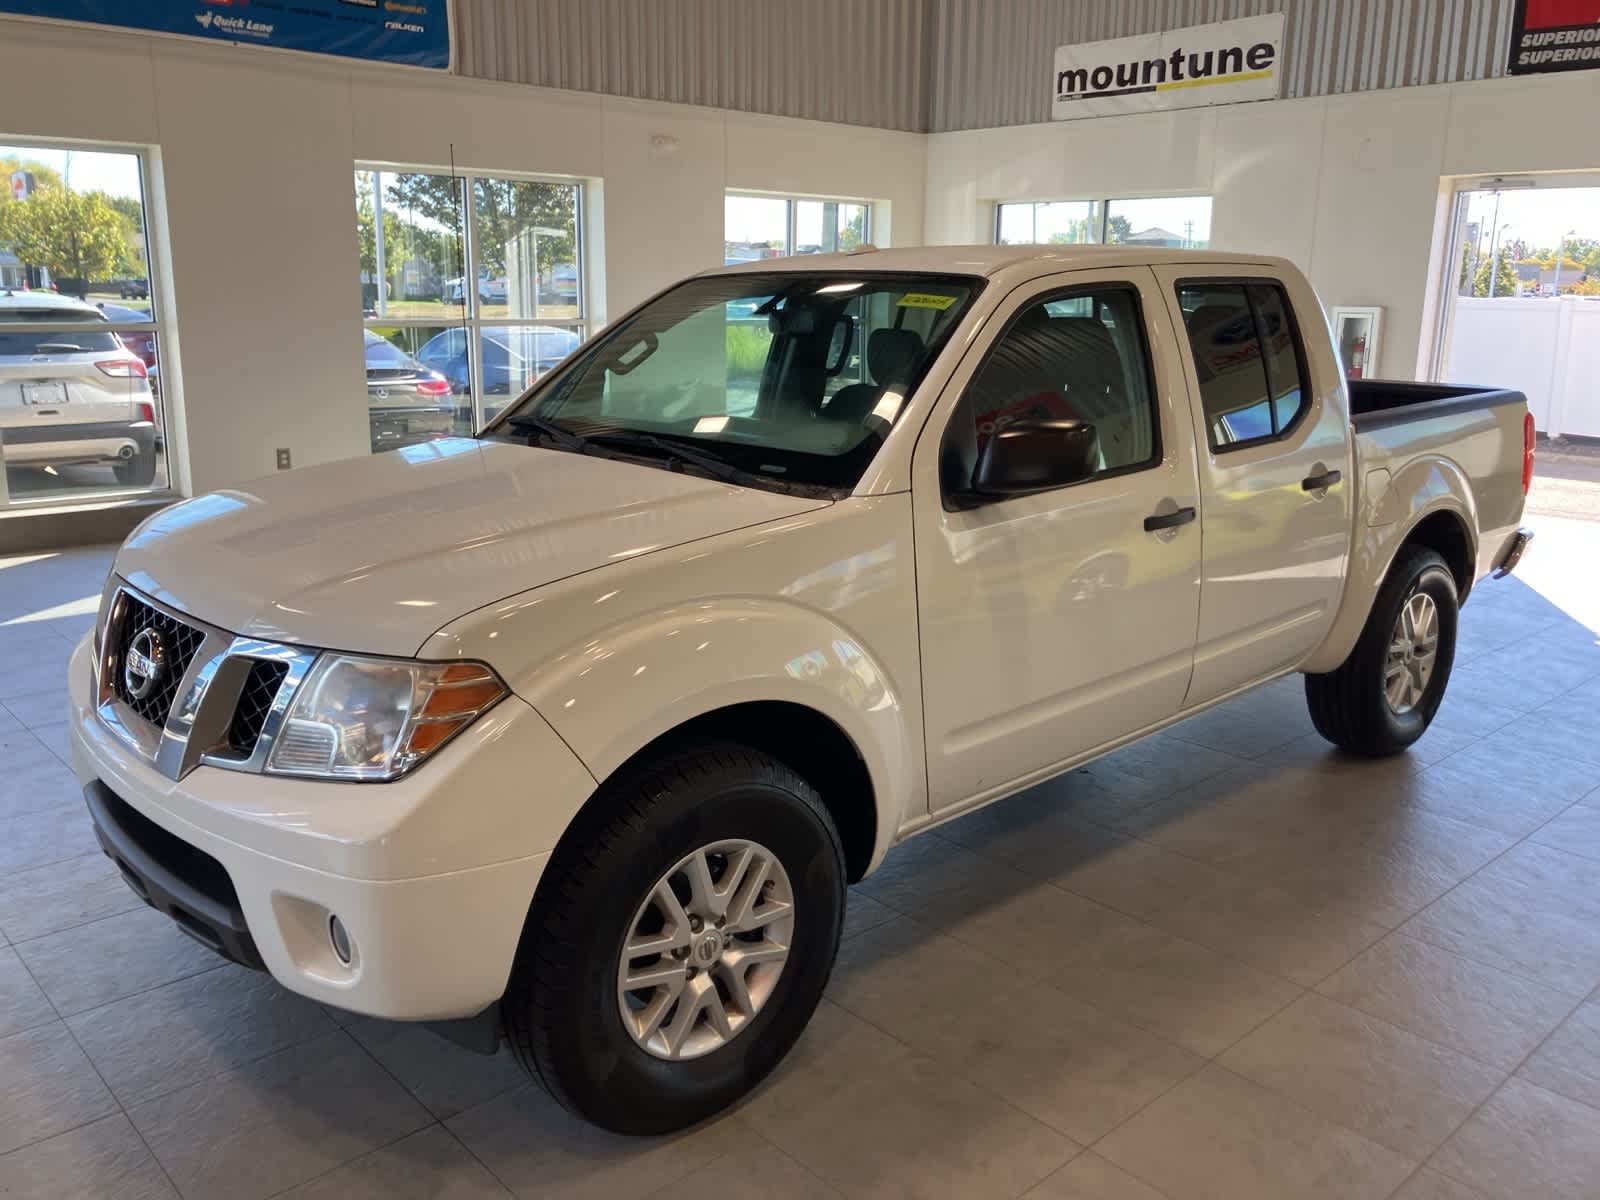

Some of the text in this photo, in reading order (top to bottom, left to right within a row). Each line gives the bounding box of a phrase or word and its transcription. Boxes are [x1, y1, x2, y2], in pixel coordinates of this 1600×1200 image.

[213, 16, 246, 28] Quick
[246, 20, 273, 32] Lane
[1057, 42, 1276, 94] mountune
